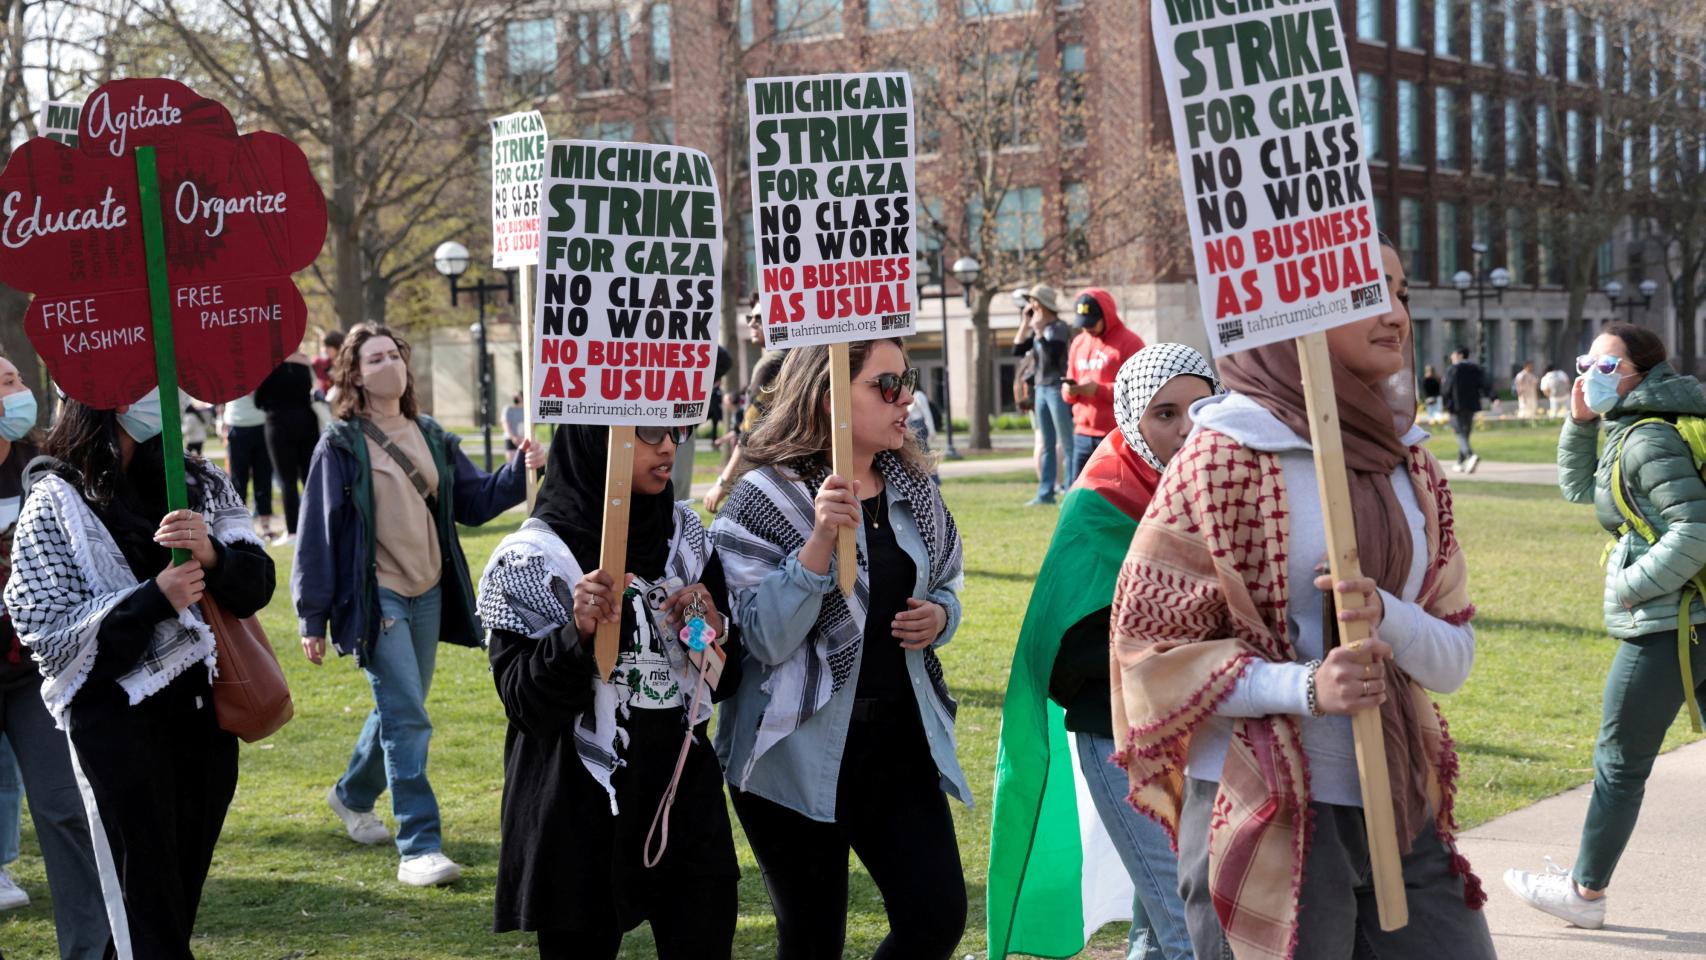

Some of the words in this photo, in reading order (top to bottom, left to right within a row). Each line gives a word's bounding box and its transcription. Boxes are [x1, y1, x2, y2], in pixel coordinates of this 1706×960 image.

[1174, 8, 1343, 98] STRIKE
[755, 77, 906, 114] MICHIGAN
[1184, 94, 1260, 149] FOR
[1269, 76, 1353, 130] GAZA
[88, 92, 182, 156] Agitate
[494, 114, 543, 137] MICHIGAN
[756, 113, 908, 166] STRIKE
[496, 135, 544, 165] STRIKE
[551, 145, 712, 187] MICHIGAN
[1192, 147, 1242, 195] NO
[1260, 122, 1358, 179] CLASS
[496, 167, 512, 185] FOR
[516, 163, 543, 182] GAZA
[758, 168, 818, 202] FOR
[827, 163, 908, 197] GAZA
[175, 181, 286, 237] Organize
[496, 188, 507, 203] NO
[512, 183, 542, 201] CLAS
[496, 205, 507, 219] NO
[512, 201, 538, 217] WOR
[1197, 191, 1247, 236] NO
[1263, 164, 1365, 220] WORK
[1, 186, 127, 248] Educate
[496, 222, 505, 234] NO
[509, 218, 540, 233] BUSINES
[548, 184, 716, 238] STRIKE
[760, 204, 800, 235] NO
[816, 197, 910, 230] CLASS
[497, 236, 508, 252] AS
[513, 233, 539, 250] USUA
[546, 236, 614, 273] FOR
[625, 241, 714, 276] GAZA
[762, 235, 800, 265] NO
[816, 227, 909, 260] WORK
[1205, 236, 1244, 274] NO
[1252, 206, 1370, 265] BUSINESS
[764, 266, 794, 292] NO
[803, 257, 910, 289] BUSINESS
[1216, 269, 1263, 319] AS
[1274, 243, 1378, 303] USUAL
[177, 286, 223, 307] FREE
[544, 274, 591, 305] NO
[609, 277, 713, 310] CLASS
[769, 292, 805, 324] AS
[817, 283, 910, 321] USUAL
[1351, 284, 1383, 303] DIVEST!
[42, 299, 98, 328] FREE
[201, 305, 282, 329] PALESTNE
[543, 306, 588, 336] NO
[607, 309, 713, 340] WORK
[791, 321, 876, 337] tahrirumich.org
[882, 313, 910, 327] DIVEST!
[1247, 299, 1347, 333] tahrirumich.org
[63, 326, 145, 355] KASHMIR
[540, 339, 577, 364] NO
[588, 340, 710, 368] BUSINESS
[540, 367, 586, 398] AS
[600, 368, 706, 400] USUAL
[567, 402, 667, 418] tahrirumich.org
[673, 402, 704, 416] DIVEST!
[650, 668, 670, 680] mist
